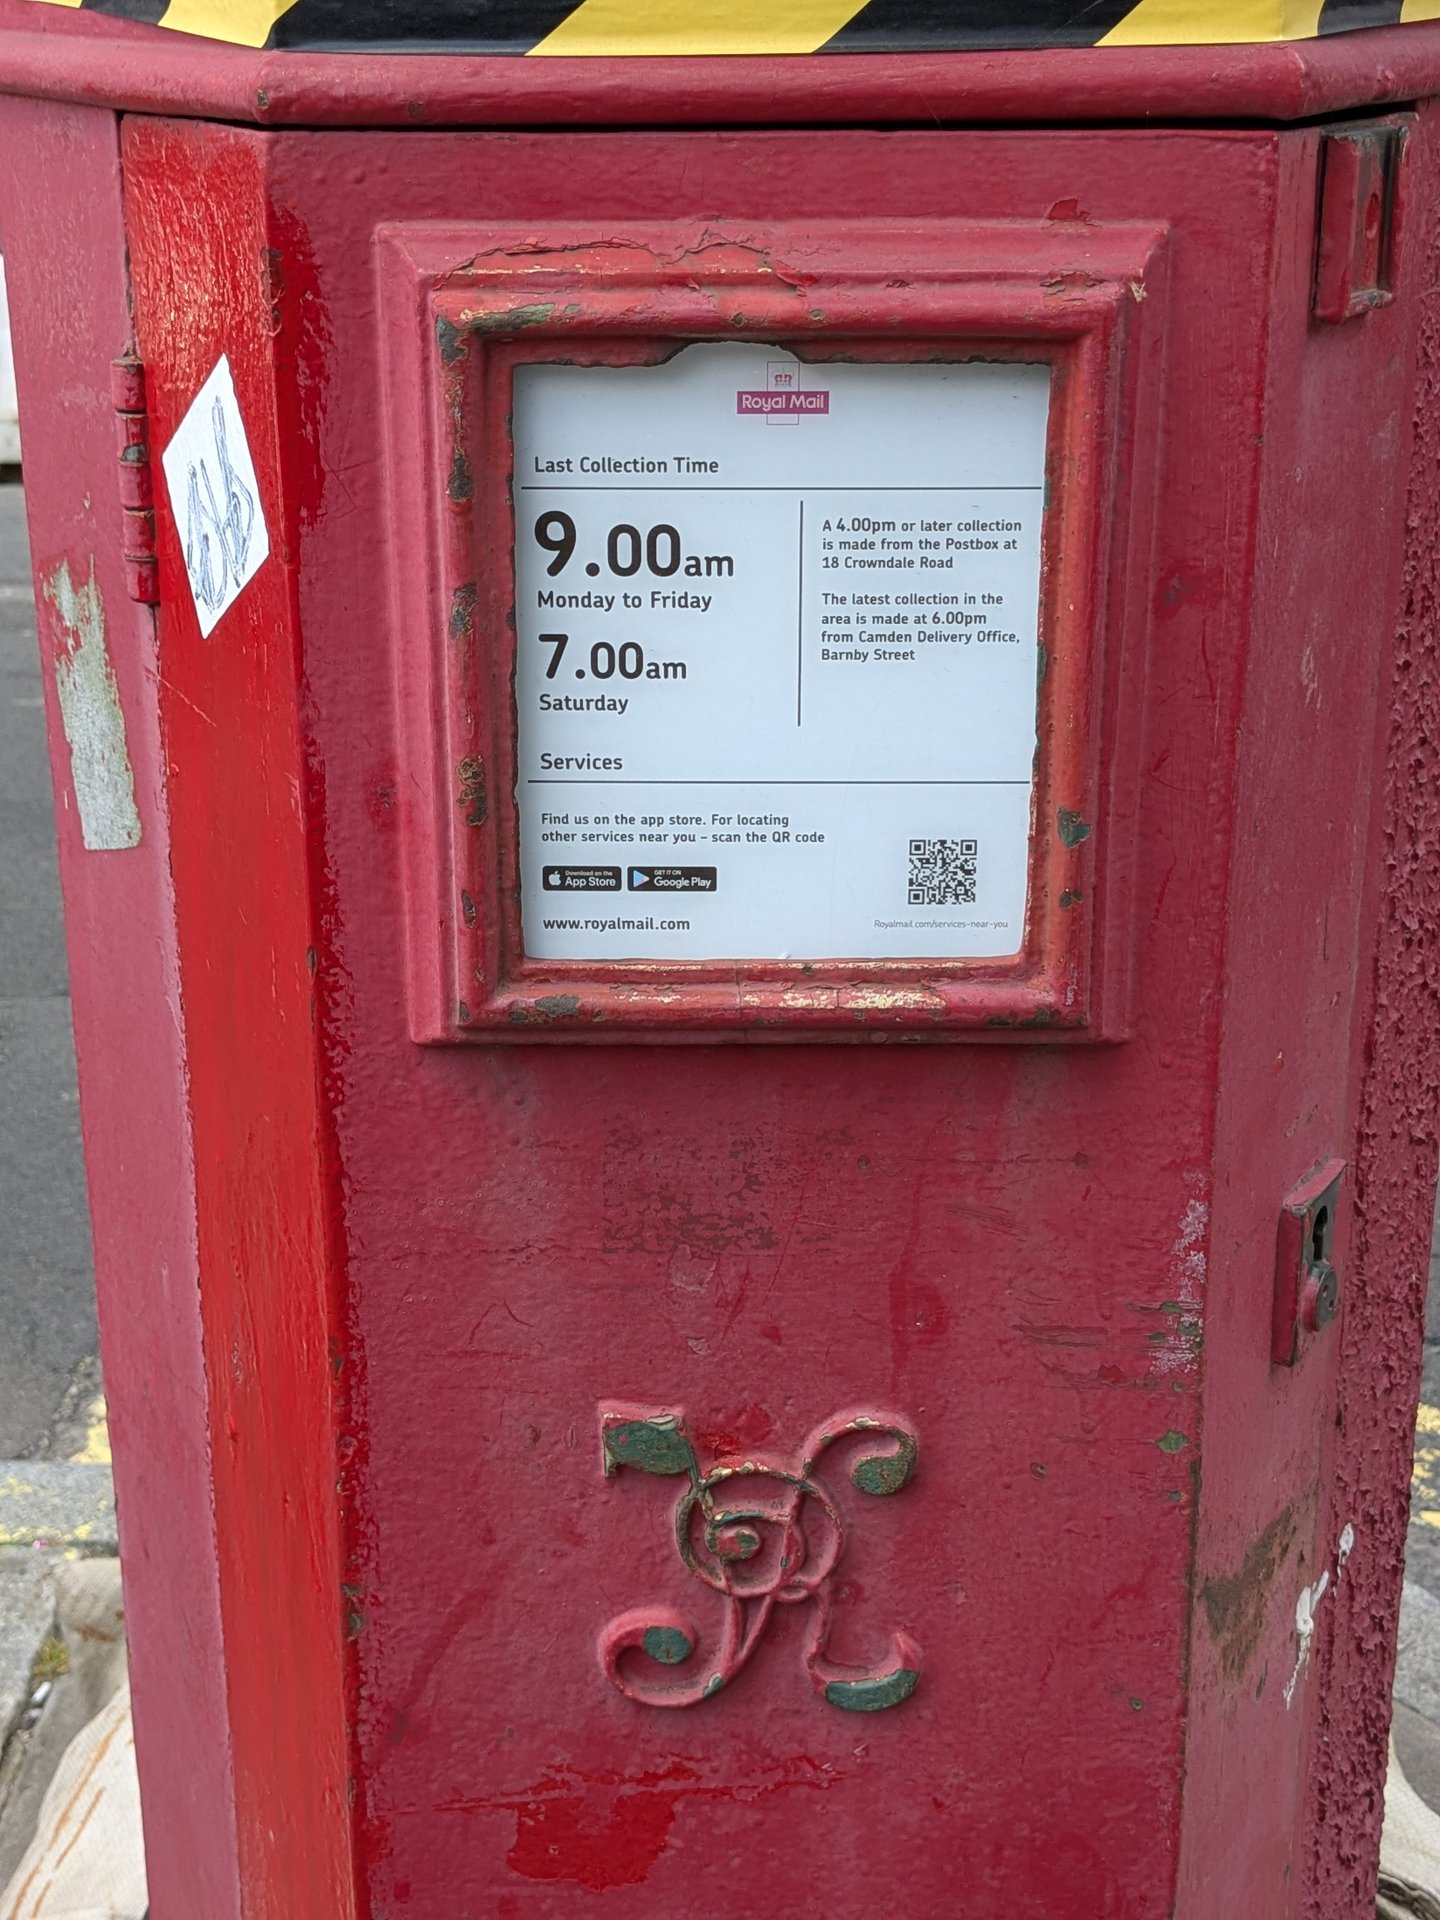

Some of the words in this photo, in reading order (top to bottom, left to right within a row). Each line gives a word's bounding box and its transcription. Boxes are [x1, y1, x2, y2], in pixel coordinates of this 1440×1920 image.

[742, 394, 785, 412] Royal
[788, 394, 824, 409] Mail
[535, 456, 573, 472] Last
[580, 457, 667, 473] Collection
[673, 457, 718, 473] Time
[823, 520, 831, 531] A
[836, 518, 895, 534] 4.00pm
[902, 523, 916, 531] or
[921, 520, 952, 531] later
[957, 519, 1021, 531] collection
[534, 510, 734, 577] 9.00am
[823, 538, 833, 550] is
[839, 538, 876, 550] made
[881, 538, 913, 550] from
[919, 538, 940, 550] the
[946, 538, 998, 550] Postbox
[1004, 539, 1017, 549] at
[823, 556, 839, 568] 18
[845, 557, 914, 568] Crowndale
[920, 556, 953, 568] Road
[538, 590, 615, 612] Monday
[622, 593, 642, 608] to
[651, 591, 712, 612] Friday
[822, 593, 847, 605] The
[853, 593, 890, 605] latest
[895, 593, 958, 605] collection
[964, 593, 976, 604] in
[982, 593, 1003, 604] the
[822, 616, 851, 624] area
[856, 613, 866, 624] is
[872, 613, 908, 624] made
[914, 614, 927, 624] at
[932, 611, 986, 627] 6.00pm
[822, 631, 853, 642] from
[859, 631, 911, 642] Camden
[918, 631, 972, 645] Delivery
[977, 631, 1019, 643] Office,
[538, 633, 687, 680] 7.00am
[822, 649, 869, 662] Barnby
[874, 649, 915, 660] Street
[539, 694, 628, 714] Saturday
[540, 753, 622, 770] Services
[542, 813, 569, 824] Find
[575, 816, 589, 824] us
[615, 814, 635, 825] the
[641, 817, 664, 827] app
[669, 815, 706, 825] store.
[712, 814, 732, 825] For
[738, 814, 788, 828] locating
[542, 831, 577, 841] other
[582, 831, 634, 842] services
[639, 834, 669, 842] near
[673, 834, 696, 844] you
[712, 834, 740, 842] scan
[746, 832, 767, 842] the
[772, 831, 790, 842] QR
[795, 832, 824, 842] code
[565, 876, 587, 888] App
[588, 876, 616, 887] Store
[654, 876, 689, 889] Google
[691, 876, 712, 889] Play
[543, 917, 690, 932] www.royalmail.com
[874, 920, 1008, 929] Royalmail.com/services-near-you
